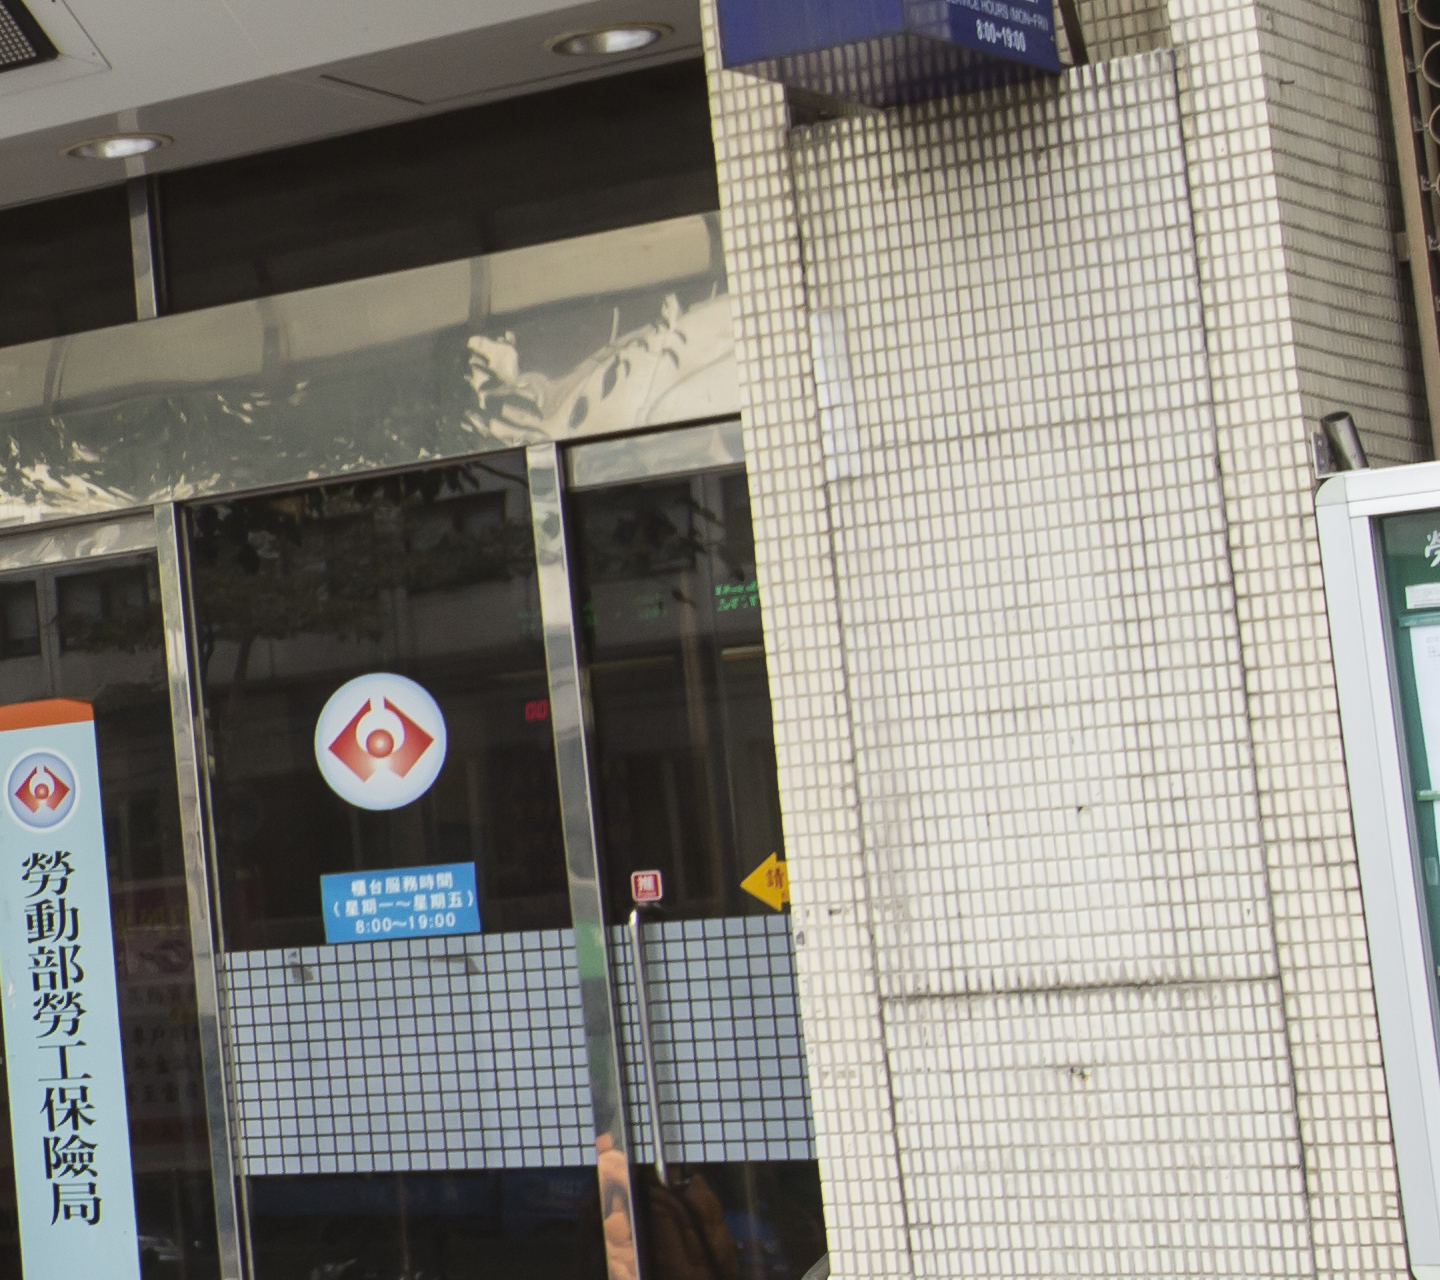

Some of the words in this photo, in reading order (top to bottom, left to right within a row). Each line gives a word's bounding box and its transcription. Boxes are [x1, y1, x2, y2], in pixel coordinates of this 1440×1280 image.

[976, 19, 1027, 53] 8:00~19:00
[351, 871, 454, 897] 櫃台服務時間
[355, 911, 456, 934] 8:00~19:00
[21, 849, 102, 1227] 勞動部勞工保險局
